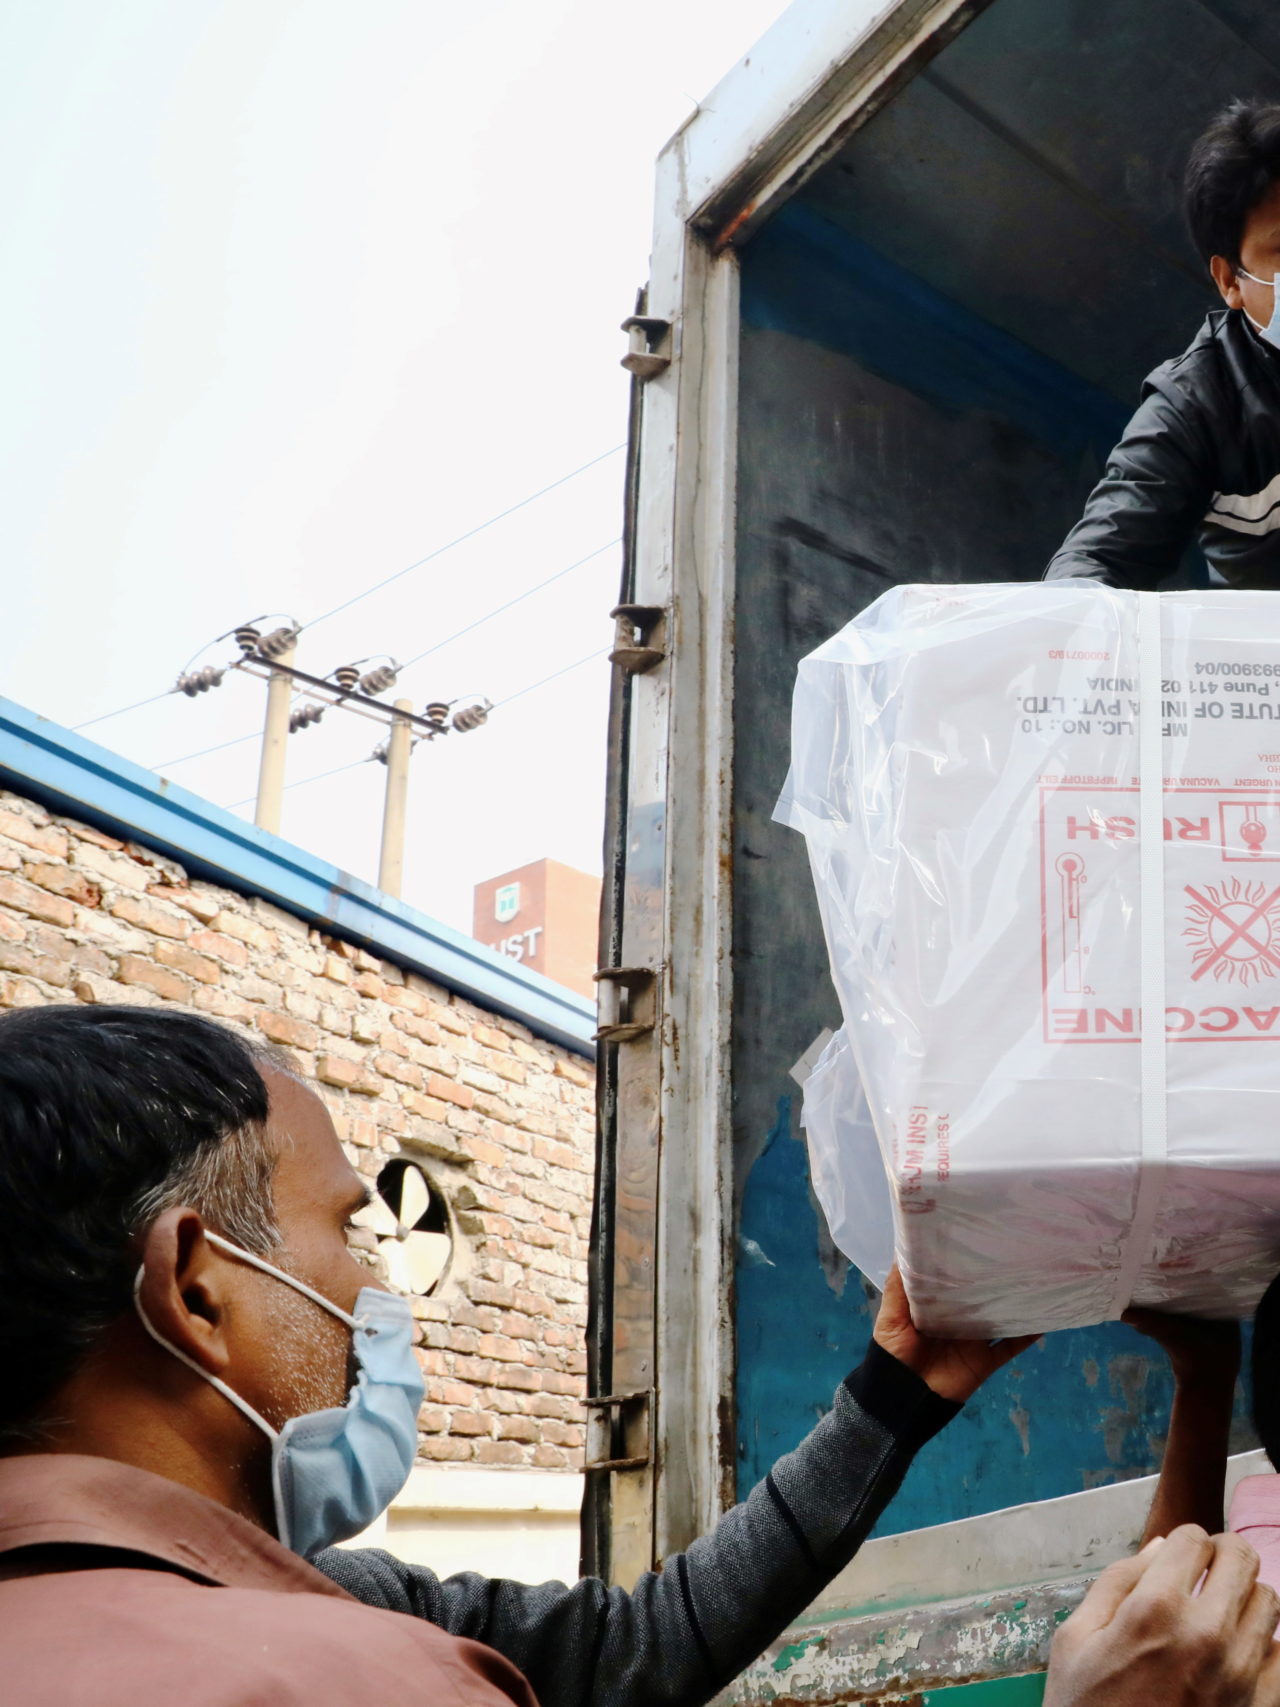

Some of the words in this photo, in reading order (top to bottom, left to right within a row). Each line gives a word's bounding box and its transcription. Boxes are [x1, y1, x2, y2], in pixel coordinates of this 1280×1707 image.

[1162, 679, 1181, 693] 02
[1190, 680, 1218, 694] 411
[1223, 681, 1269, 697] Pune
[1017, 696, 1064, 714] LTD.
[1073, 698, 1121, 716] PVT.
[1194, 701, 1224, 719] OF
[1022, 719, 1043, 734] 10
[1098, 721, 1134, 735] LIC.
[1179, 777, 1221, 786] VACUNA
[1234, 778, 1272, 787] URGENT
